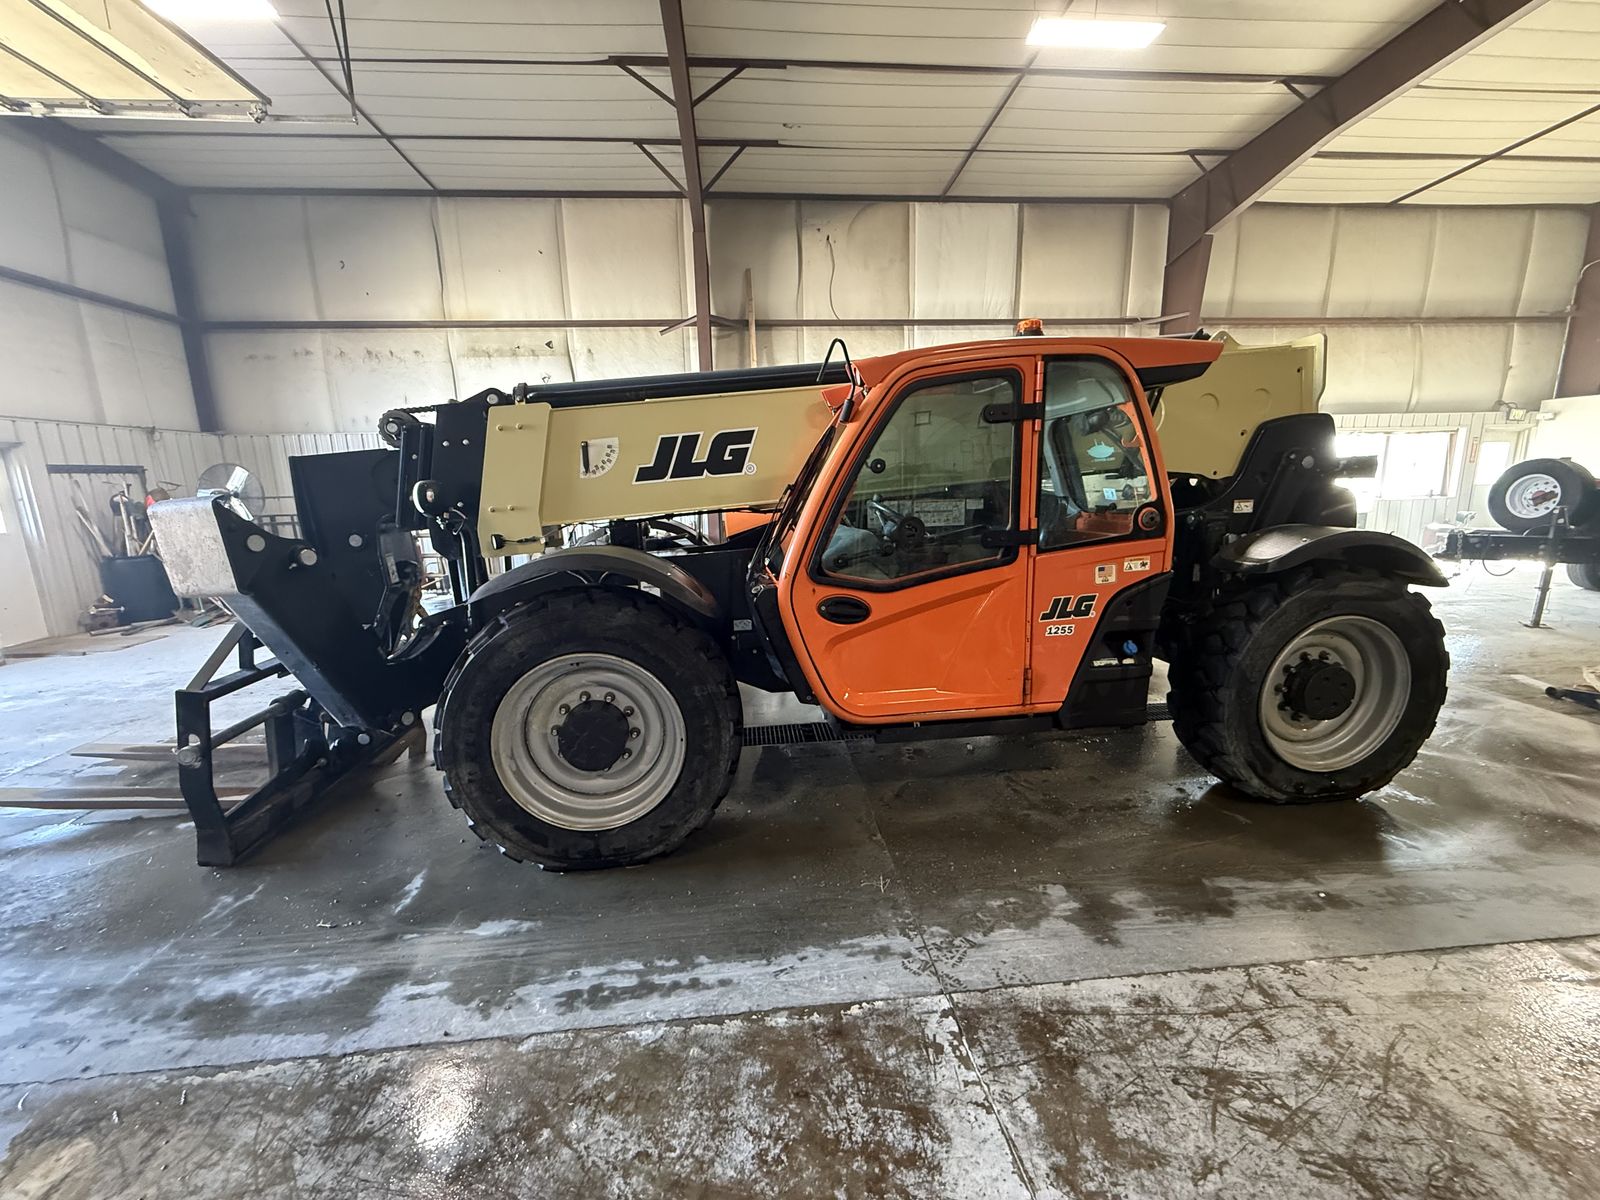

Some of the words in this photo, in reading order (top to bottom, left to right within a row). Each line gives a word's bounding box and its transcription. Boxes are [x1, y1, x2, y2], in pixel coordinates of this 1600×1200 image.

[633, 427, 757, 484] JLG
[1040, 593, 1098, 621] JLG
[1046, 625, 1074, 636] 1255
